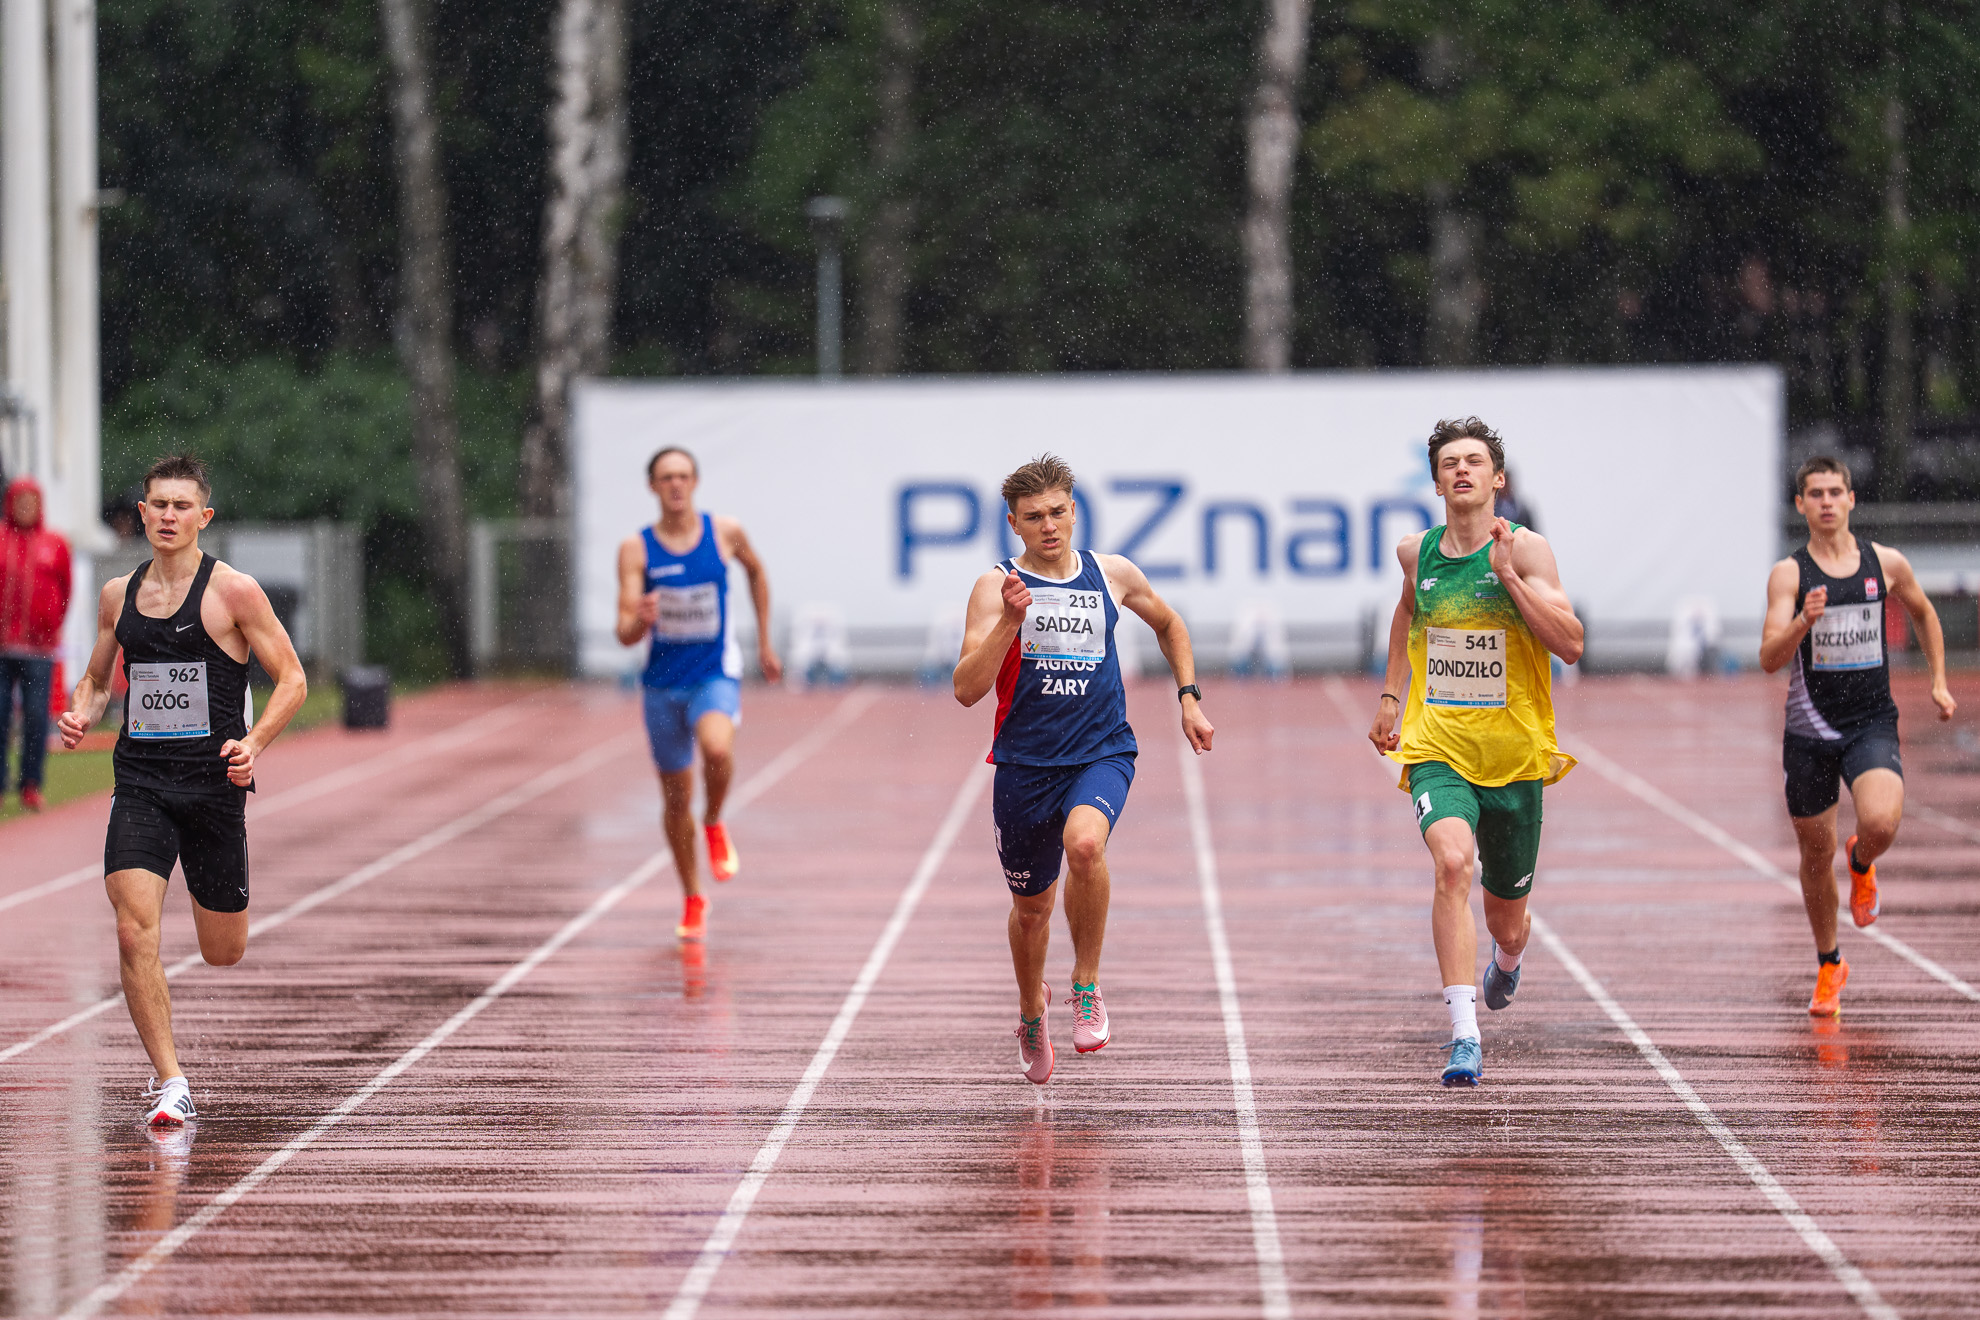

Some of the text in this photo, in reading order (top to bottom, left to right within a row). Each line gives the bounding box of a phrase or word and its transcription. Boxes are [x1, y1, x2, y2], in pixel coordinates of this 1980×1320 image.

[1069, 594, 1098, 609] 213
[1035, 615, 1094, 635] SADZA
[1465, 635, 1498, 650] 541
[1814, 628, 1880, 649] SZCZĘŚNIAK
[168, 667, 200, 683] 962
[1428, 658, 1503, 678] DONDZIŁO
[1041, 674, 1090, 696] ŻARY
[141, 689, 190, 710] OŻÓG
